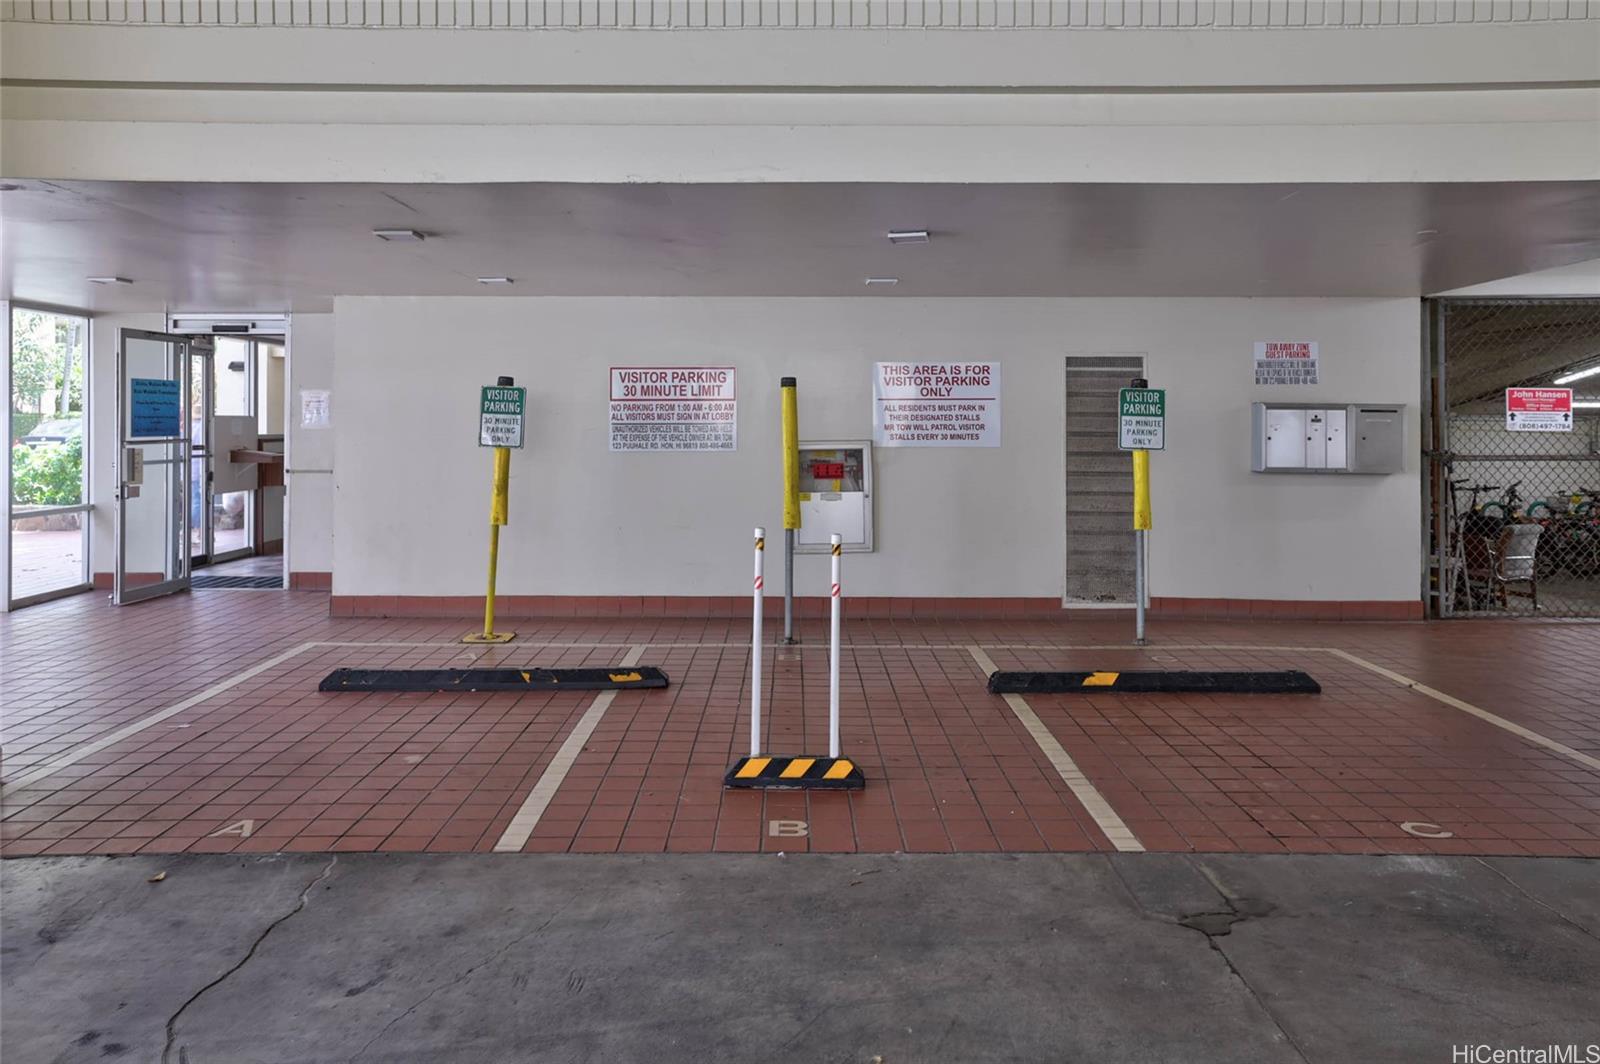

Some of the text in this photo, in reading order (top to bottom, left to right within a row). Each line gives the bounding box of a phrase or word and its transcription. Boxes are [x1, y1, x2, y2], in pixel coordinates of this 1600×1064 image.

[883, 365, 990, 375] THIS AREA IS FOR
[619, 372, 726, 383] VISITOR PARKING
[883, 376, 990, 386] VISITOR PARKING
[486, 389, 519, 401] VISITOR
[623, 385, 723, 396] 30 MINUTE LIMIT
[920, 387, 952, 397] ONLY
[1125, 391, 1160, 403] VISITOR
[484, 401, 521, 413] PARKING
[1123, 403, 1162, 415] PARKING
[495, 417, 520, 425] MINUTE
[486, 426, 516, 434] PARKING
[208, 820, 254, 837] A
[769, 820, 808, 836] B
[1400, 822, 1453, 838] C
